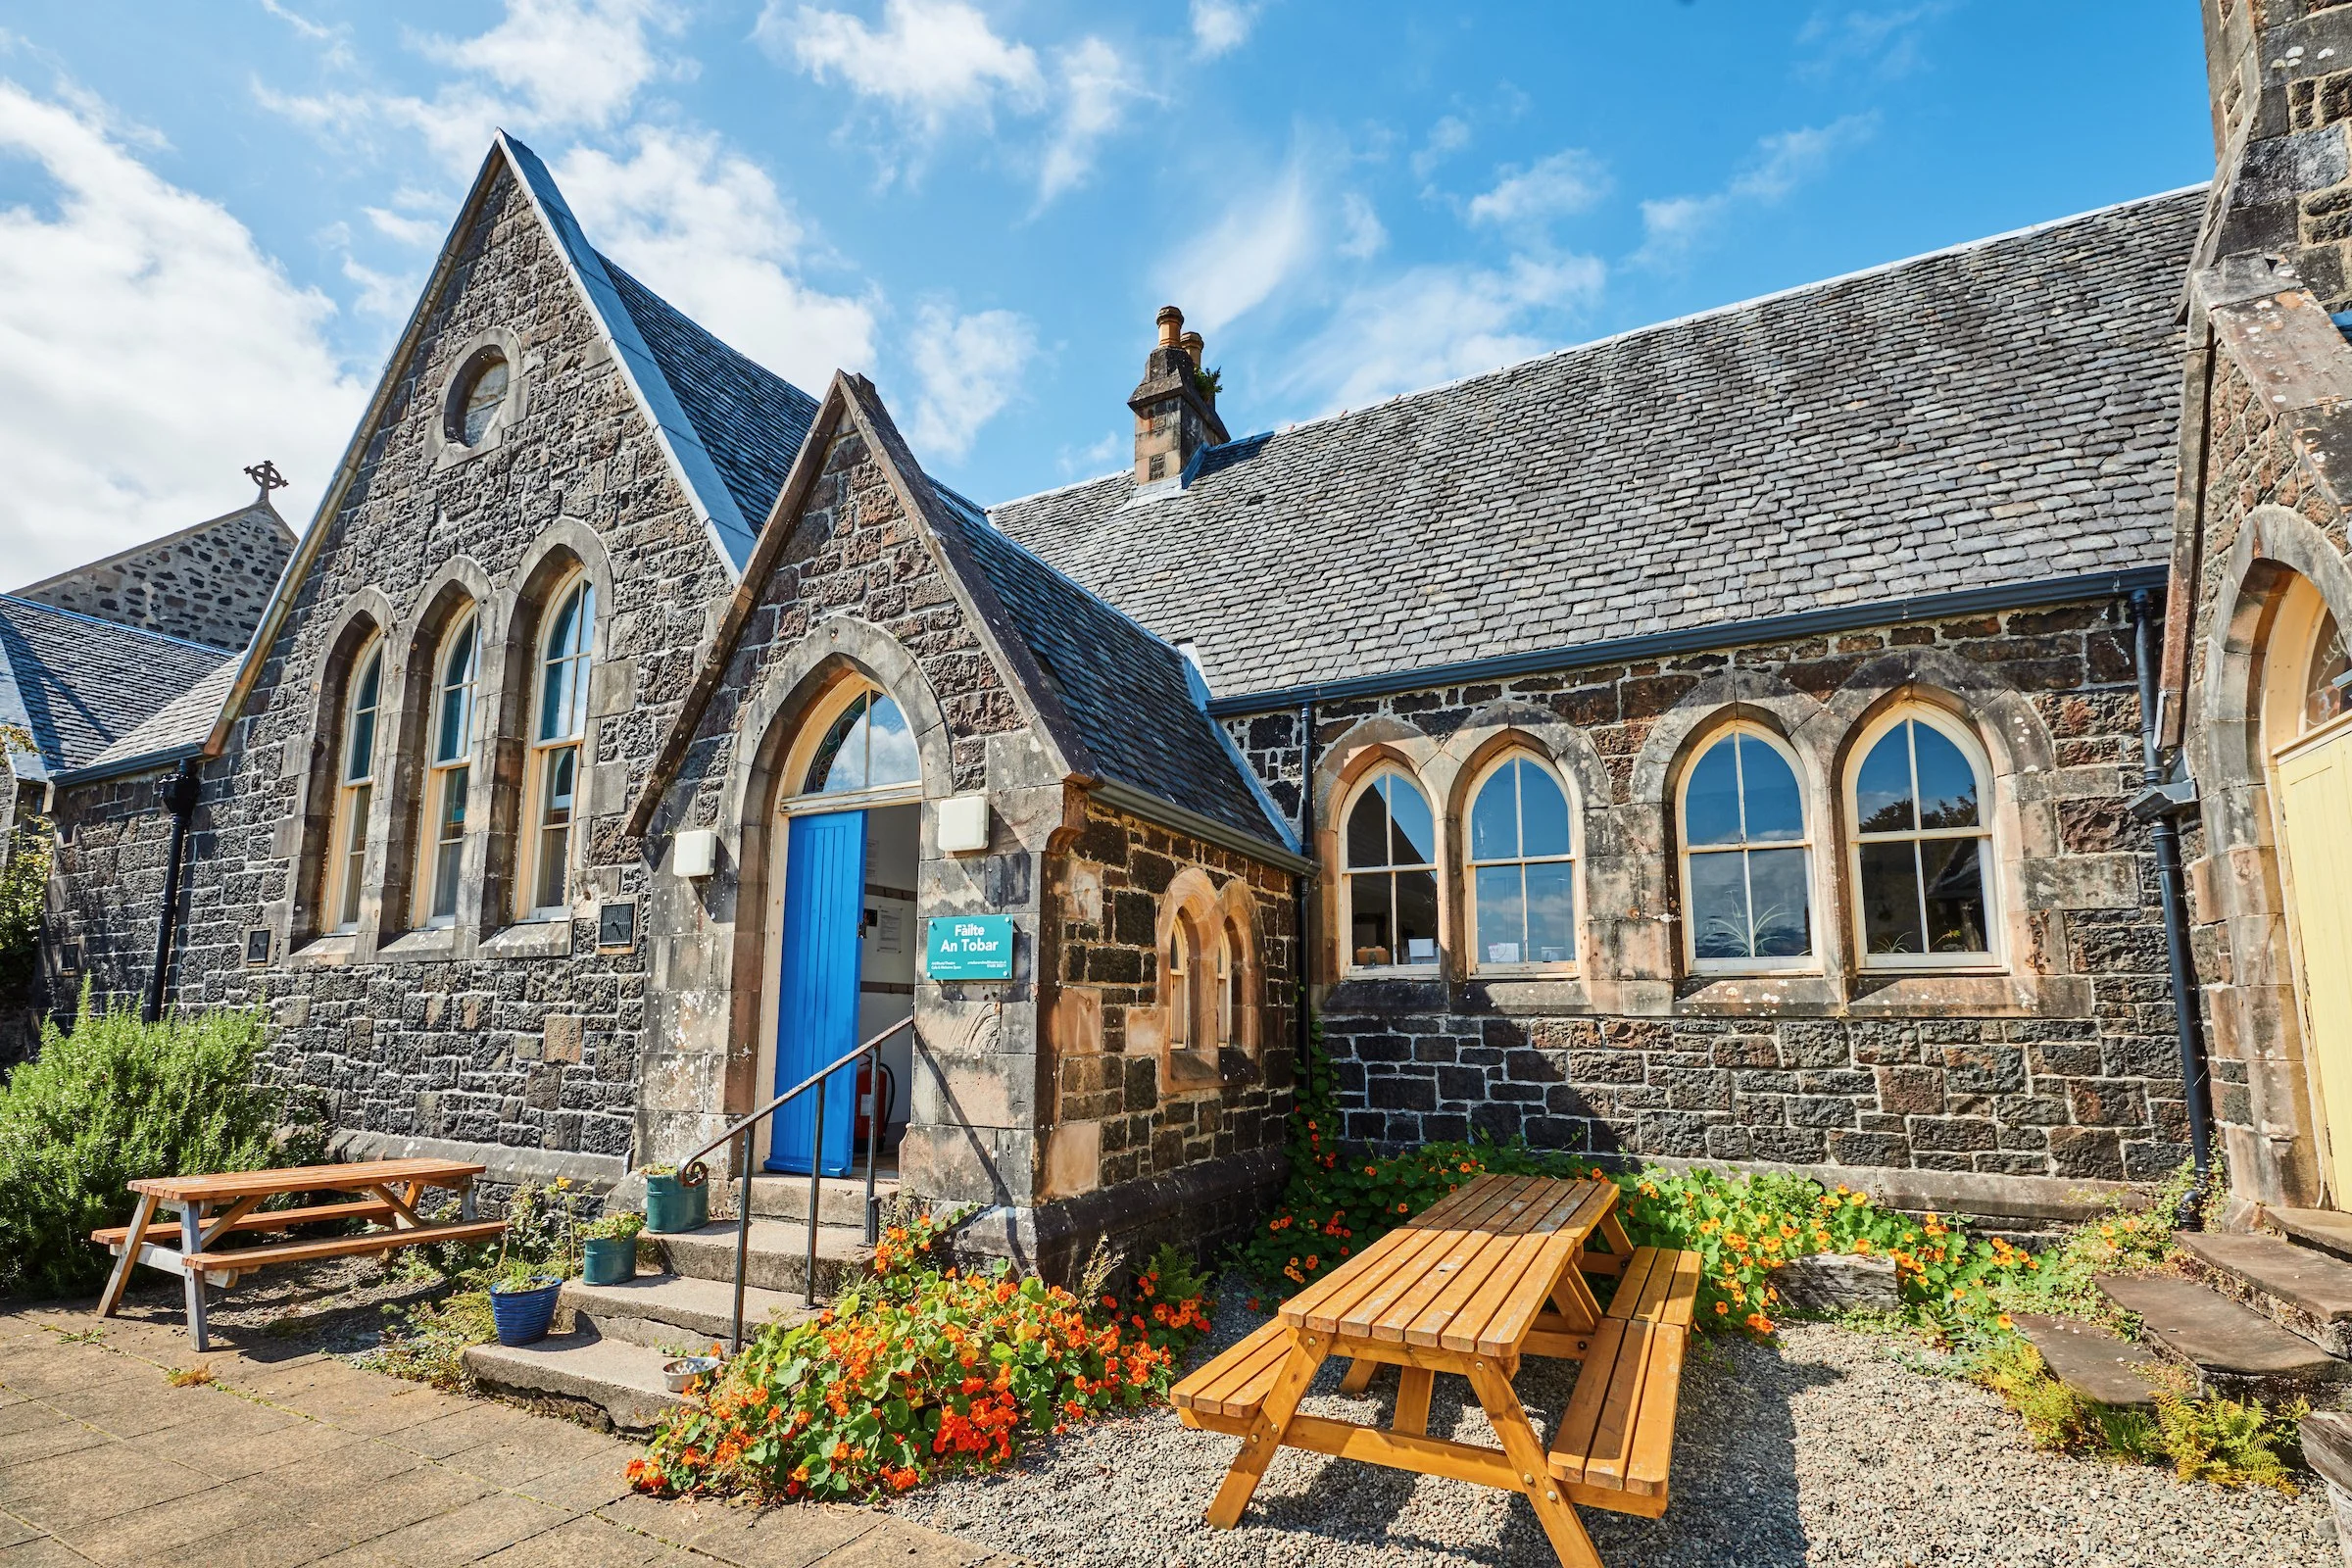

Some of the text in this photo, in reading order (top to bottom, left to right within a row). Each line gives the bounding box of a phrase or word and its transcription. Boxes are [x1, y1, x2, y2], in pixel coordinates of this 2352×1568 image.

[955, 923, 985, 937] Fàilte
[941, 938, 999, 953] An Tobar
